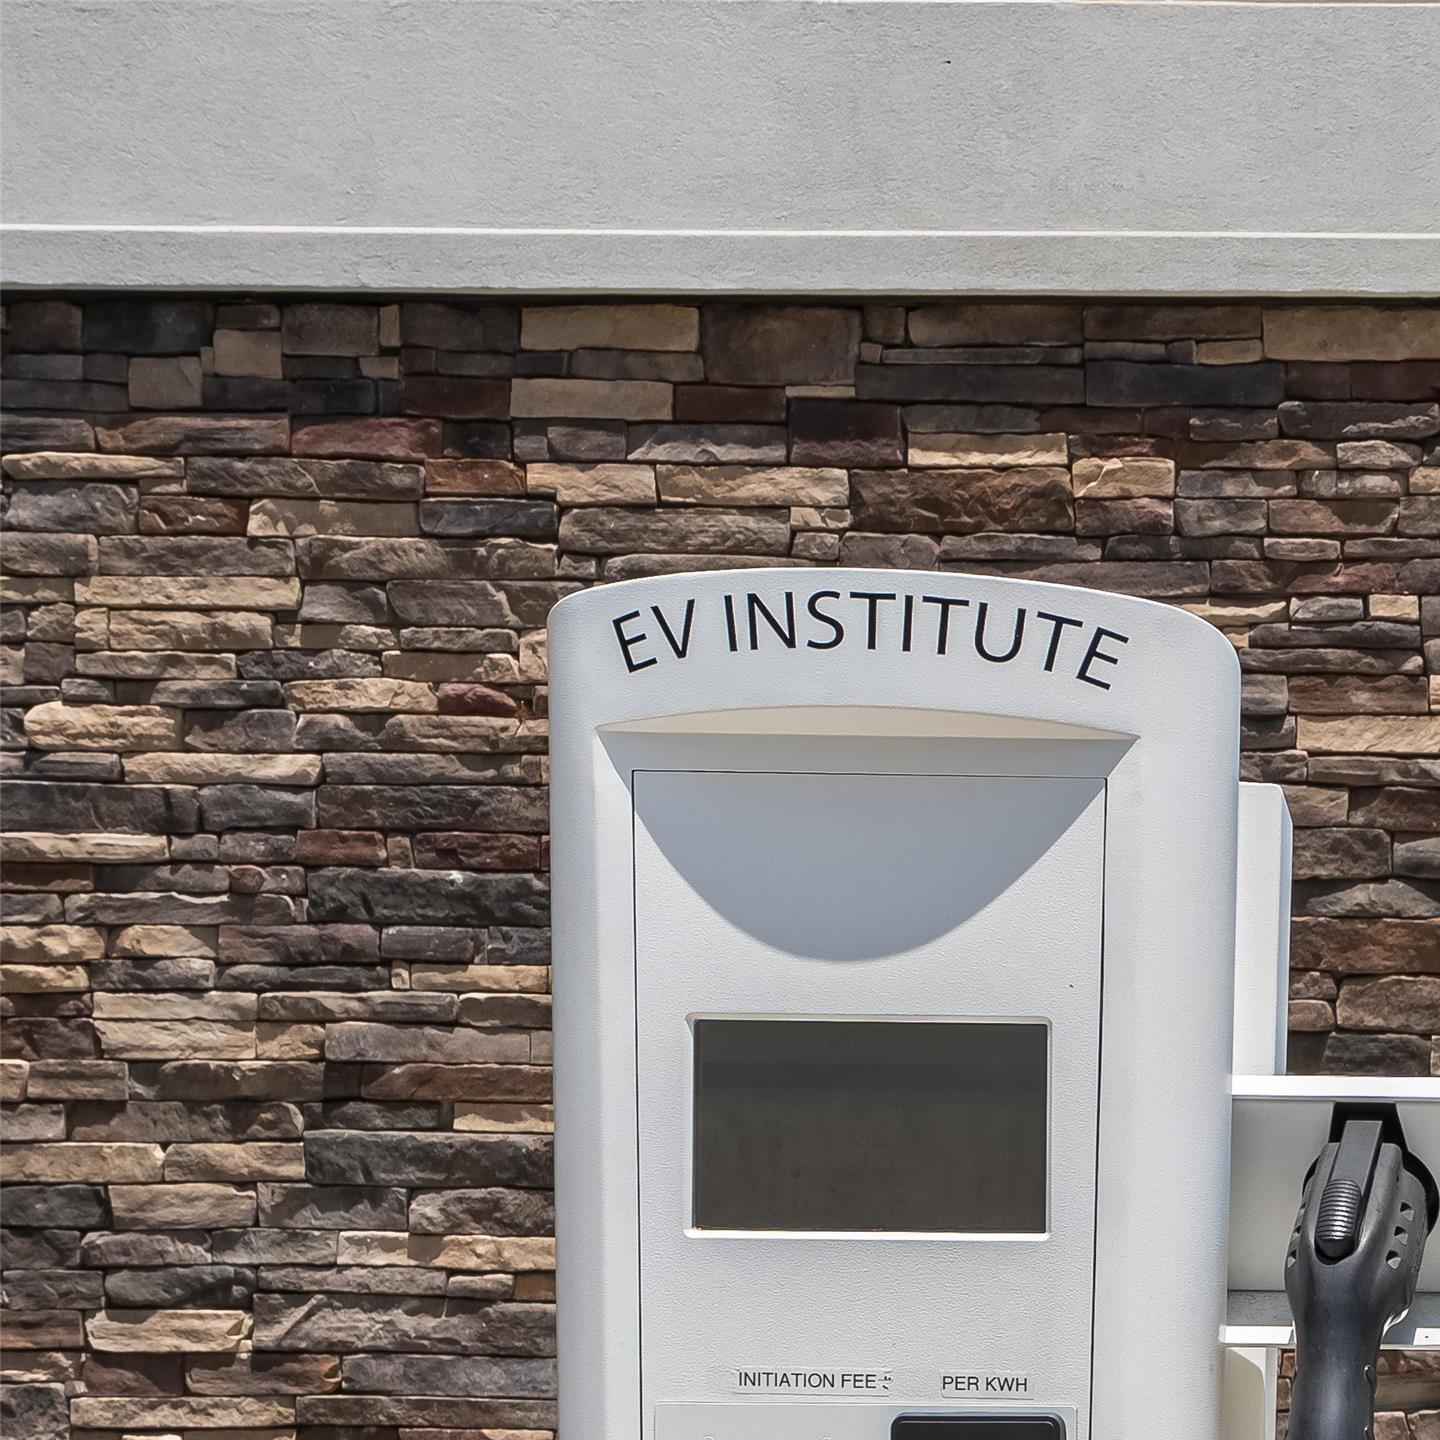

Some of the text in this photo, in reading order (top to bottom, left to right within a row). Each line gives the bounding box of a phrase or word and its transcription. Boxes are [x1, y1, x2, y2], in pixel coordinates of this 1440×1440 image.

[613, 591, 1129, 691] EV INSTITUTE
[737, 1371, 835, 1388] INITIATION
[841, 1373, 877, 1389] FEE
[942, 1375, 1028, 1392] PER KWH
